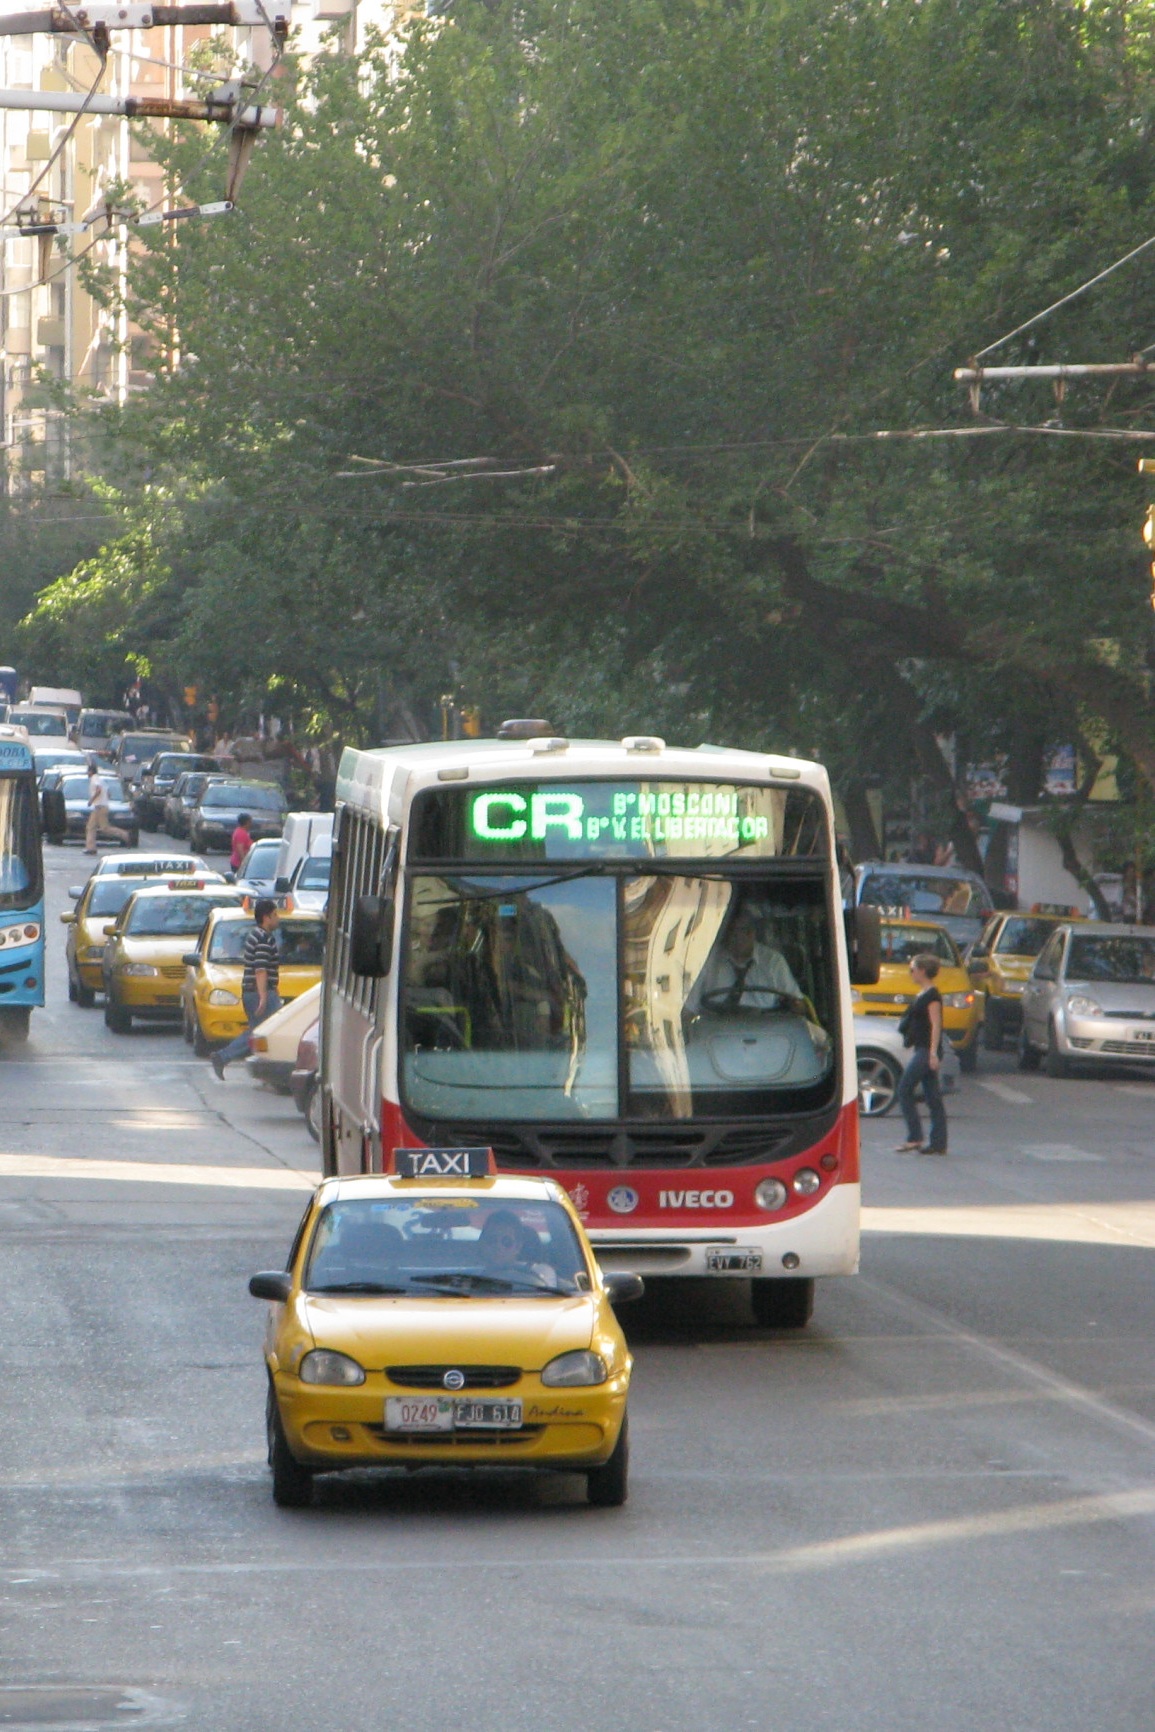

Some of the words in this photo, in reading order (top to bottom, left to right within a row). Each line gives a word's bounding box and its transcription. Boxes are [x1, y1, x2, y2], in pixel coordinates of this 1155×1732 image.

[639, 793, 738, 816] MOSCONI
[473, 793, 584, 839] CR
[631, 816, 651, 839] EL
[159, 861, 189, 870] TAXI
[408, 1153, 470, 1174] TAXI
[659, 1190, 734, 1208] IVECO
[402, 1404, 438, 1422] 0249
